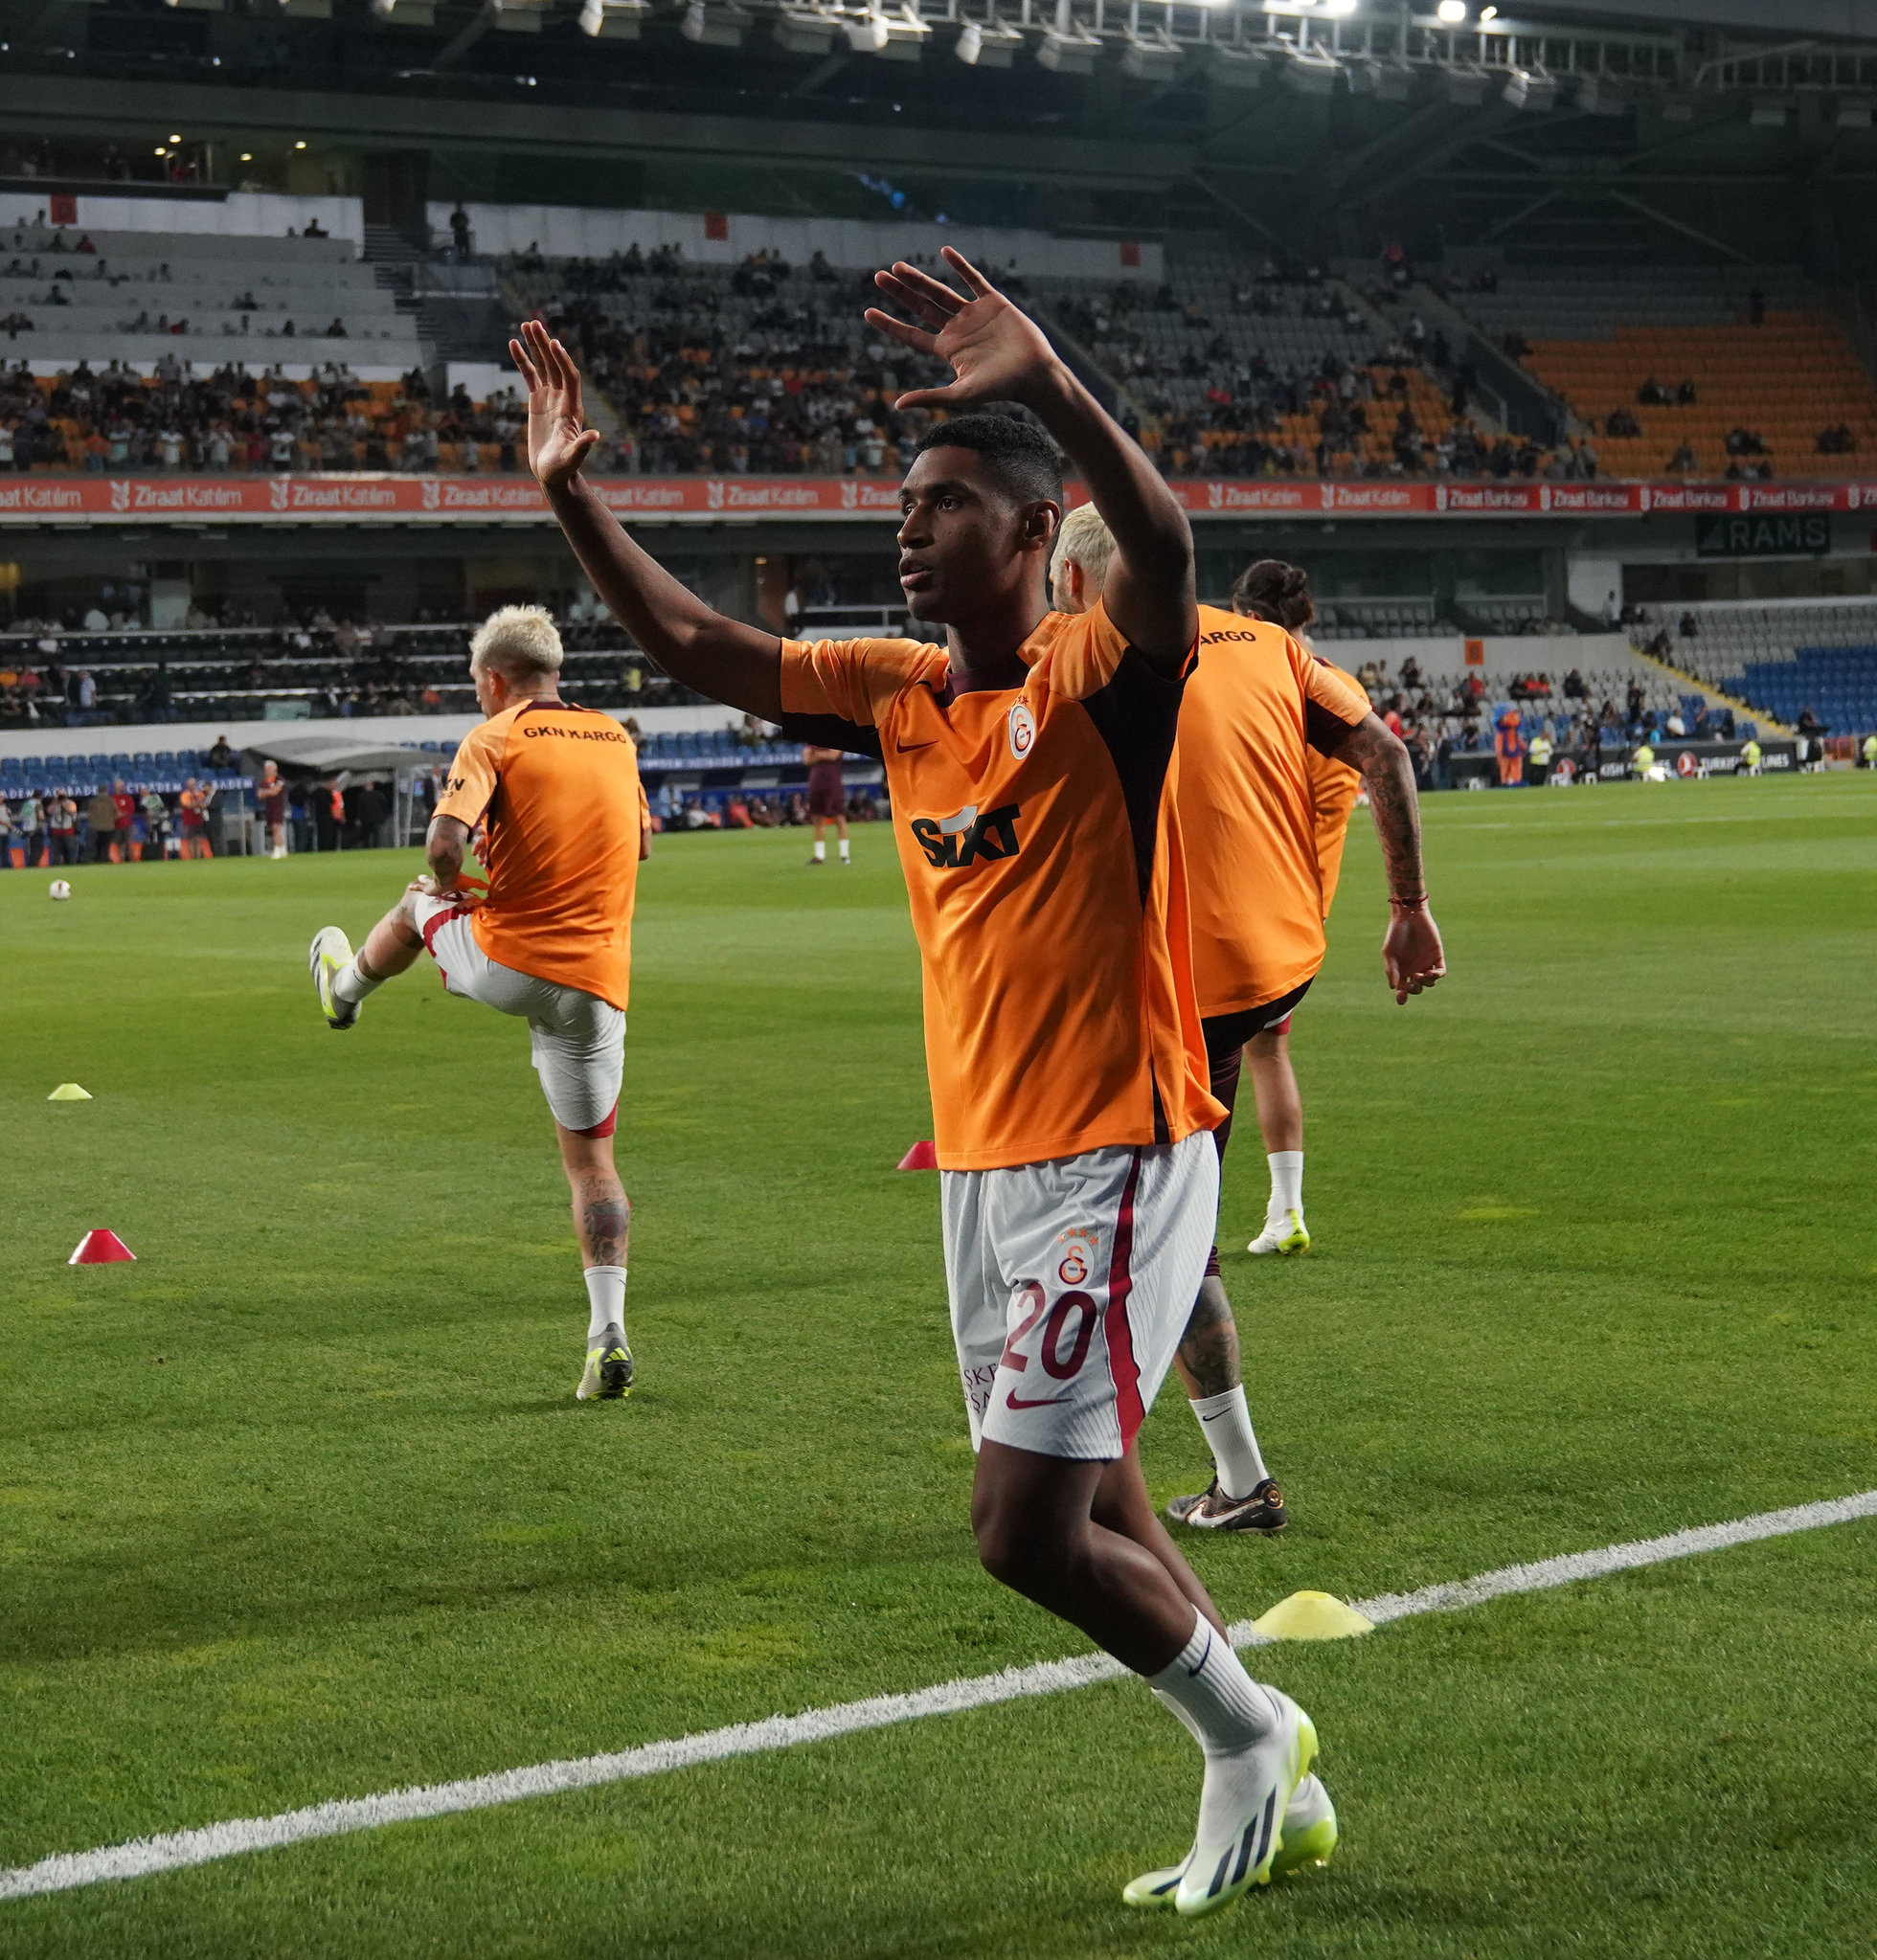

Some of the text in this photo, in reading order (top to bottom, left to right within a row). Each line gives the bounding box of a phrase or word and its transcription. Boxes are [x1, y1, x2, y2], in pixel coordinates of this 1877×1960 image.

[1729, 517, 1826, 550] RAMS
[1200, 630, 1256, 645] ARGO
[523, 726, 626, 744] GKN KARGO
[998, 1281, 1097, 1379] 20
